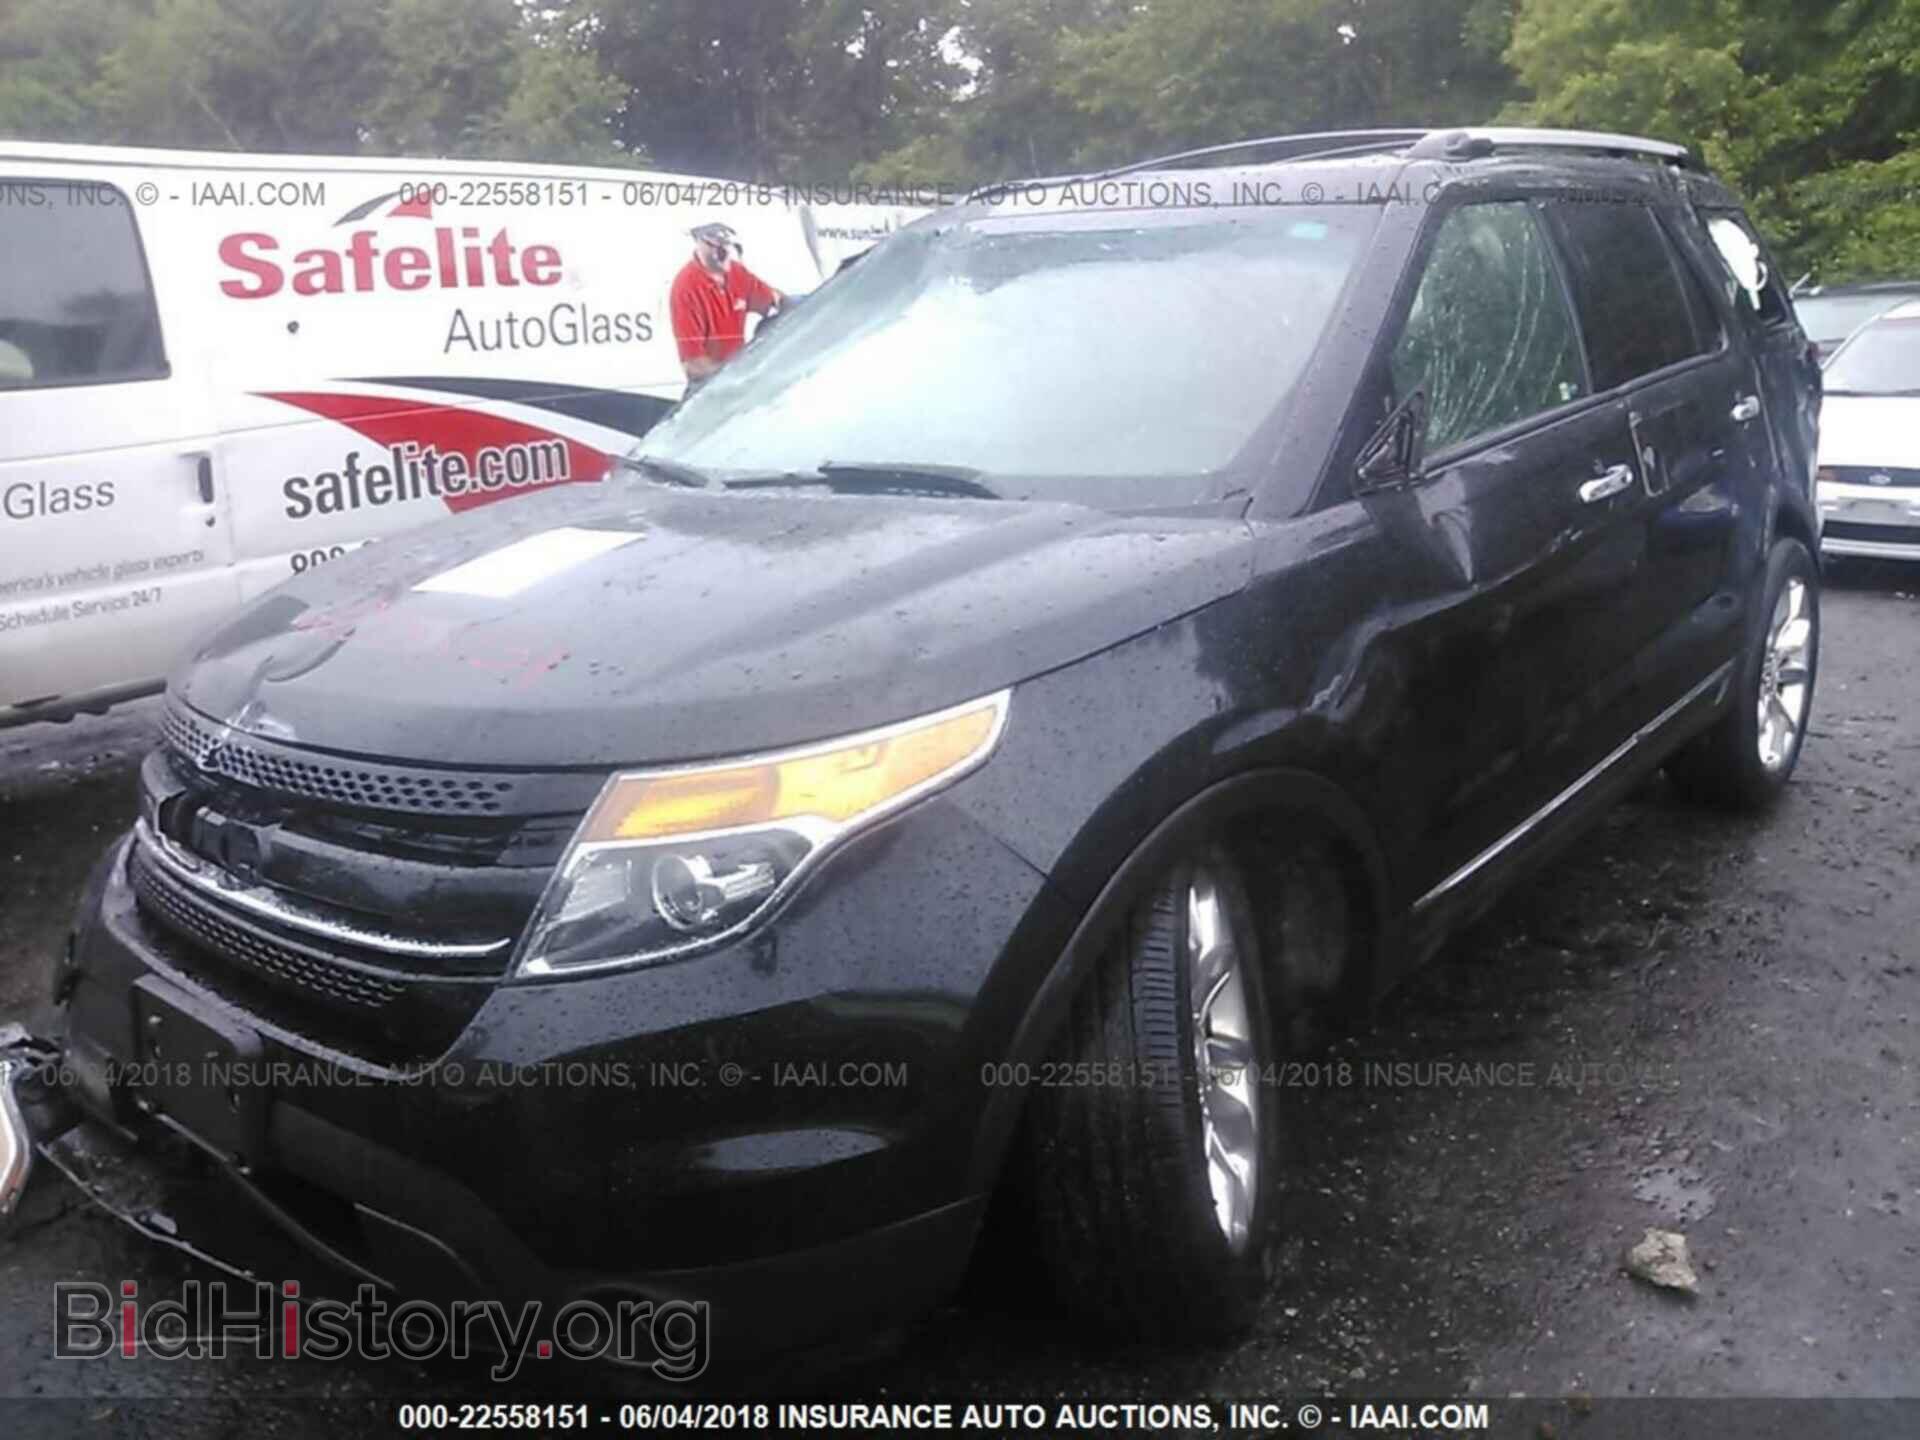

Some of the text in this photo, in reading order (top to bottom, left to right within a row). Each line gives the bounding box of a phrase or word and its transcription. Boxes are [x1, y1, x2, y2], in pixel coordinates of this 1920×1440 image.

[218, 226, 563, 300] Safelite
[443, 302, 653, 354] AutoGlass
[3, 481, 115, 519] Glass
[283, 440, 569, 519] safelite.com
[0, 586, 162, 632] Schedule Service 24/7
